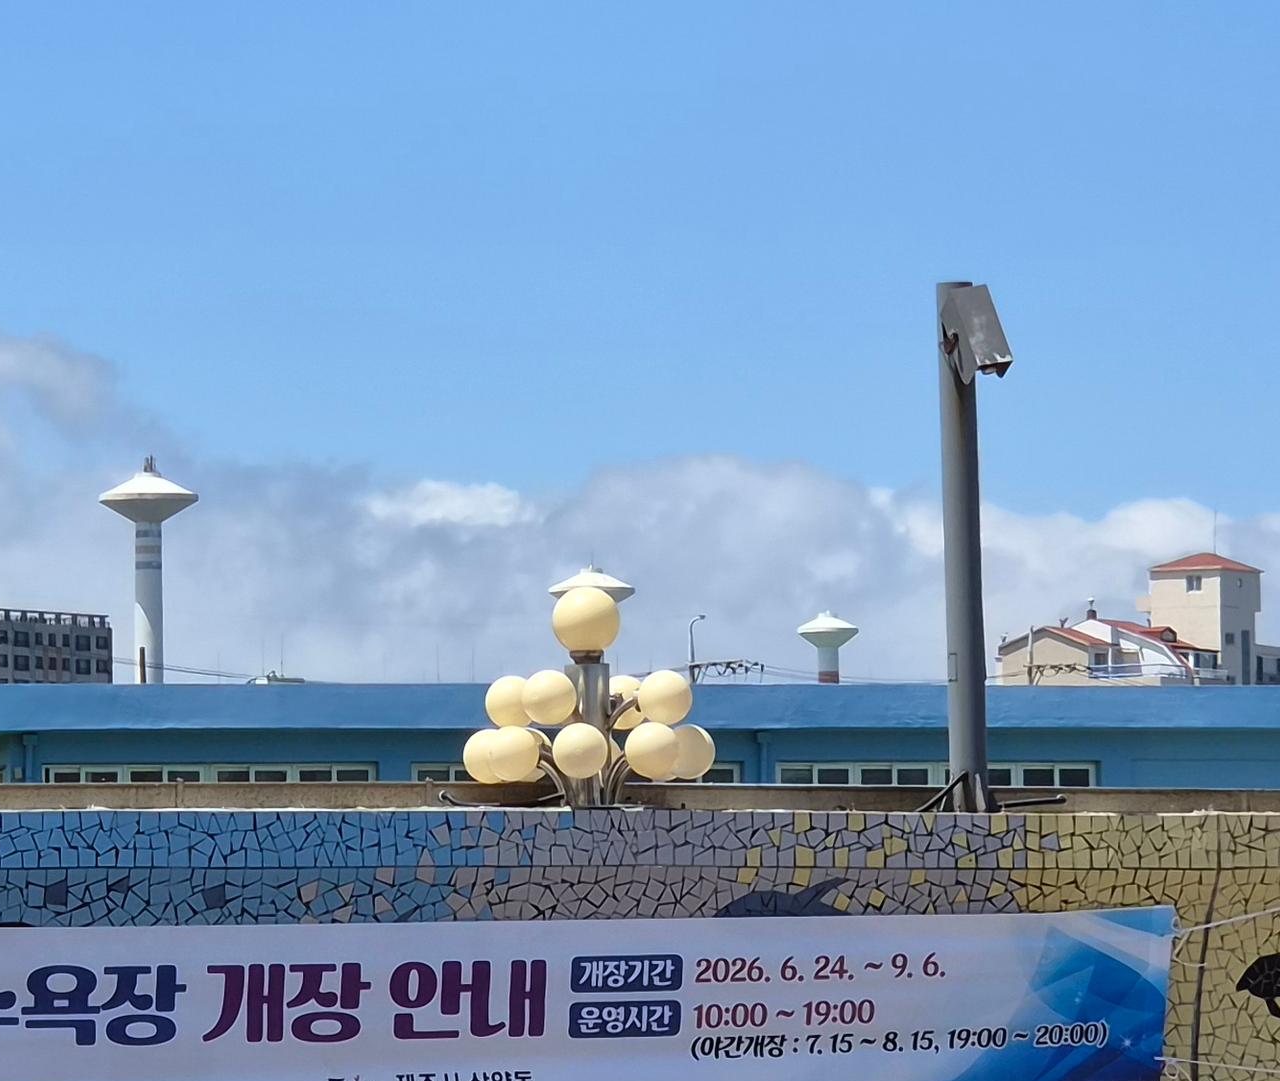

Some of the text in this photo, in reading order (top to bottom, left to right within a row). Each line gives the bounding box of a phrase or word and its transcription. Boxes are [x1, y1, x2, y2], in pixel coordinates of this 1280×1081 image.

[578, 959, 675, 988] 개장기간
[694, 956, 770, 983] 2026.
[780, 956, 804, 982] 6.
[813, 955, 854, 981] 24.
[891, 953, 913, 979] 9.
[922, 952, 946, 978] 6.
[204, 962, 371, 1043] 개장
[389, 959, 548, 1040] 안내
[577, 1005, 673, 1034] 운영시간
[693, 1002, 768, 1029] 10:00
[802, 999, 875, 1026] 19:00
[691, 1034, 787, 1060] (야간개장
[829, 1033, 853, 1054] 15
[882, 1031, 904, 1052] 8.
[911, 1030, 940, 1054] 15,
[948, 1027, 1006, 1050] 19:00
[1034, 1022, 1108, 1047] 20:00)
